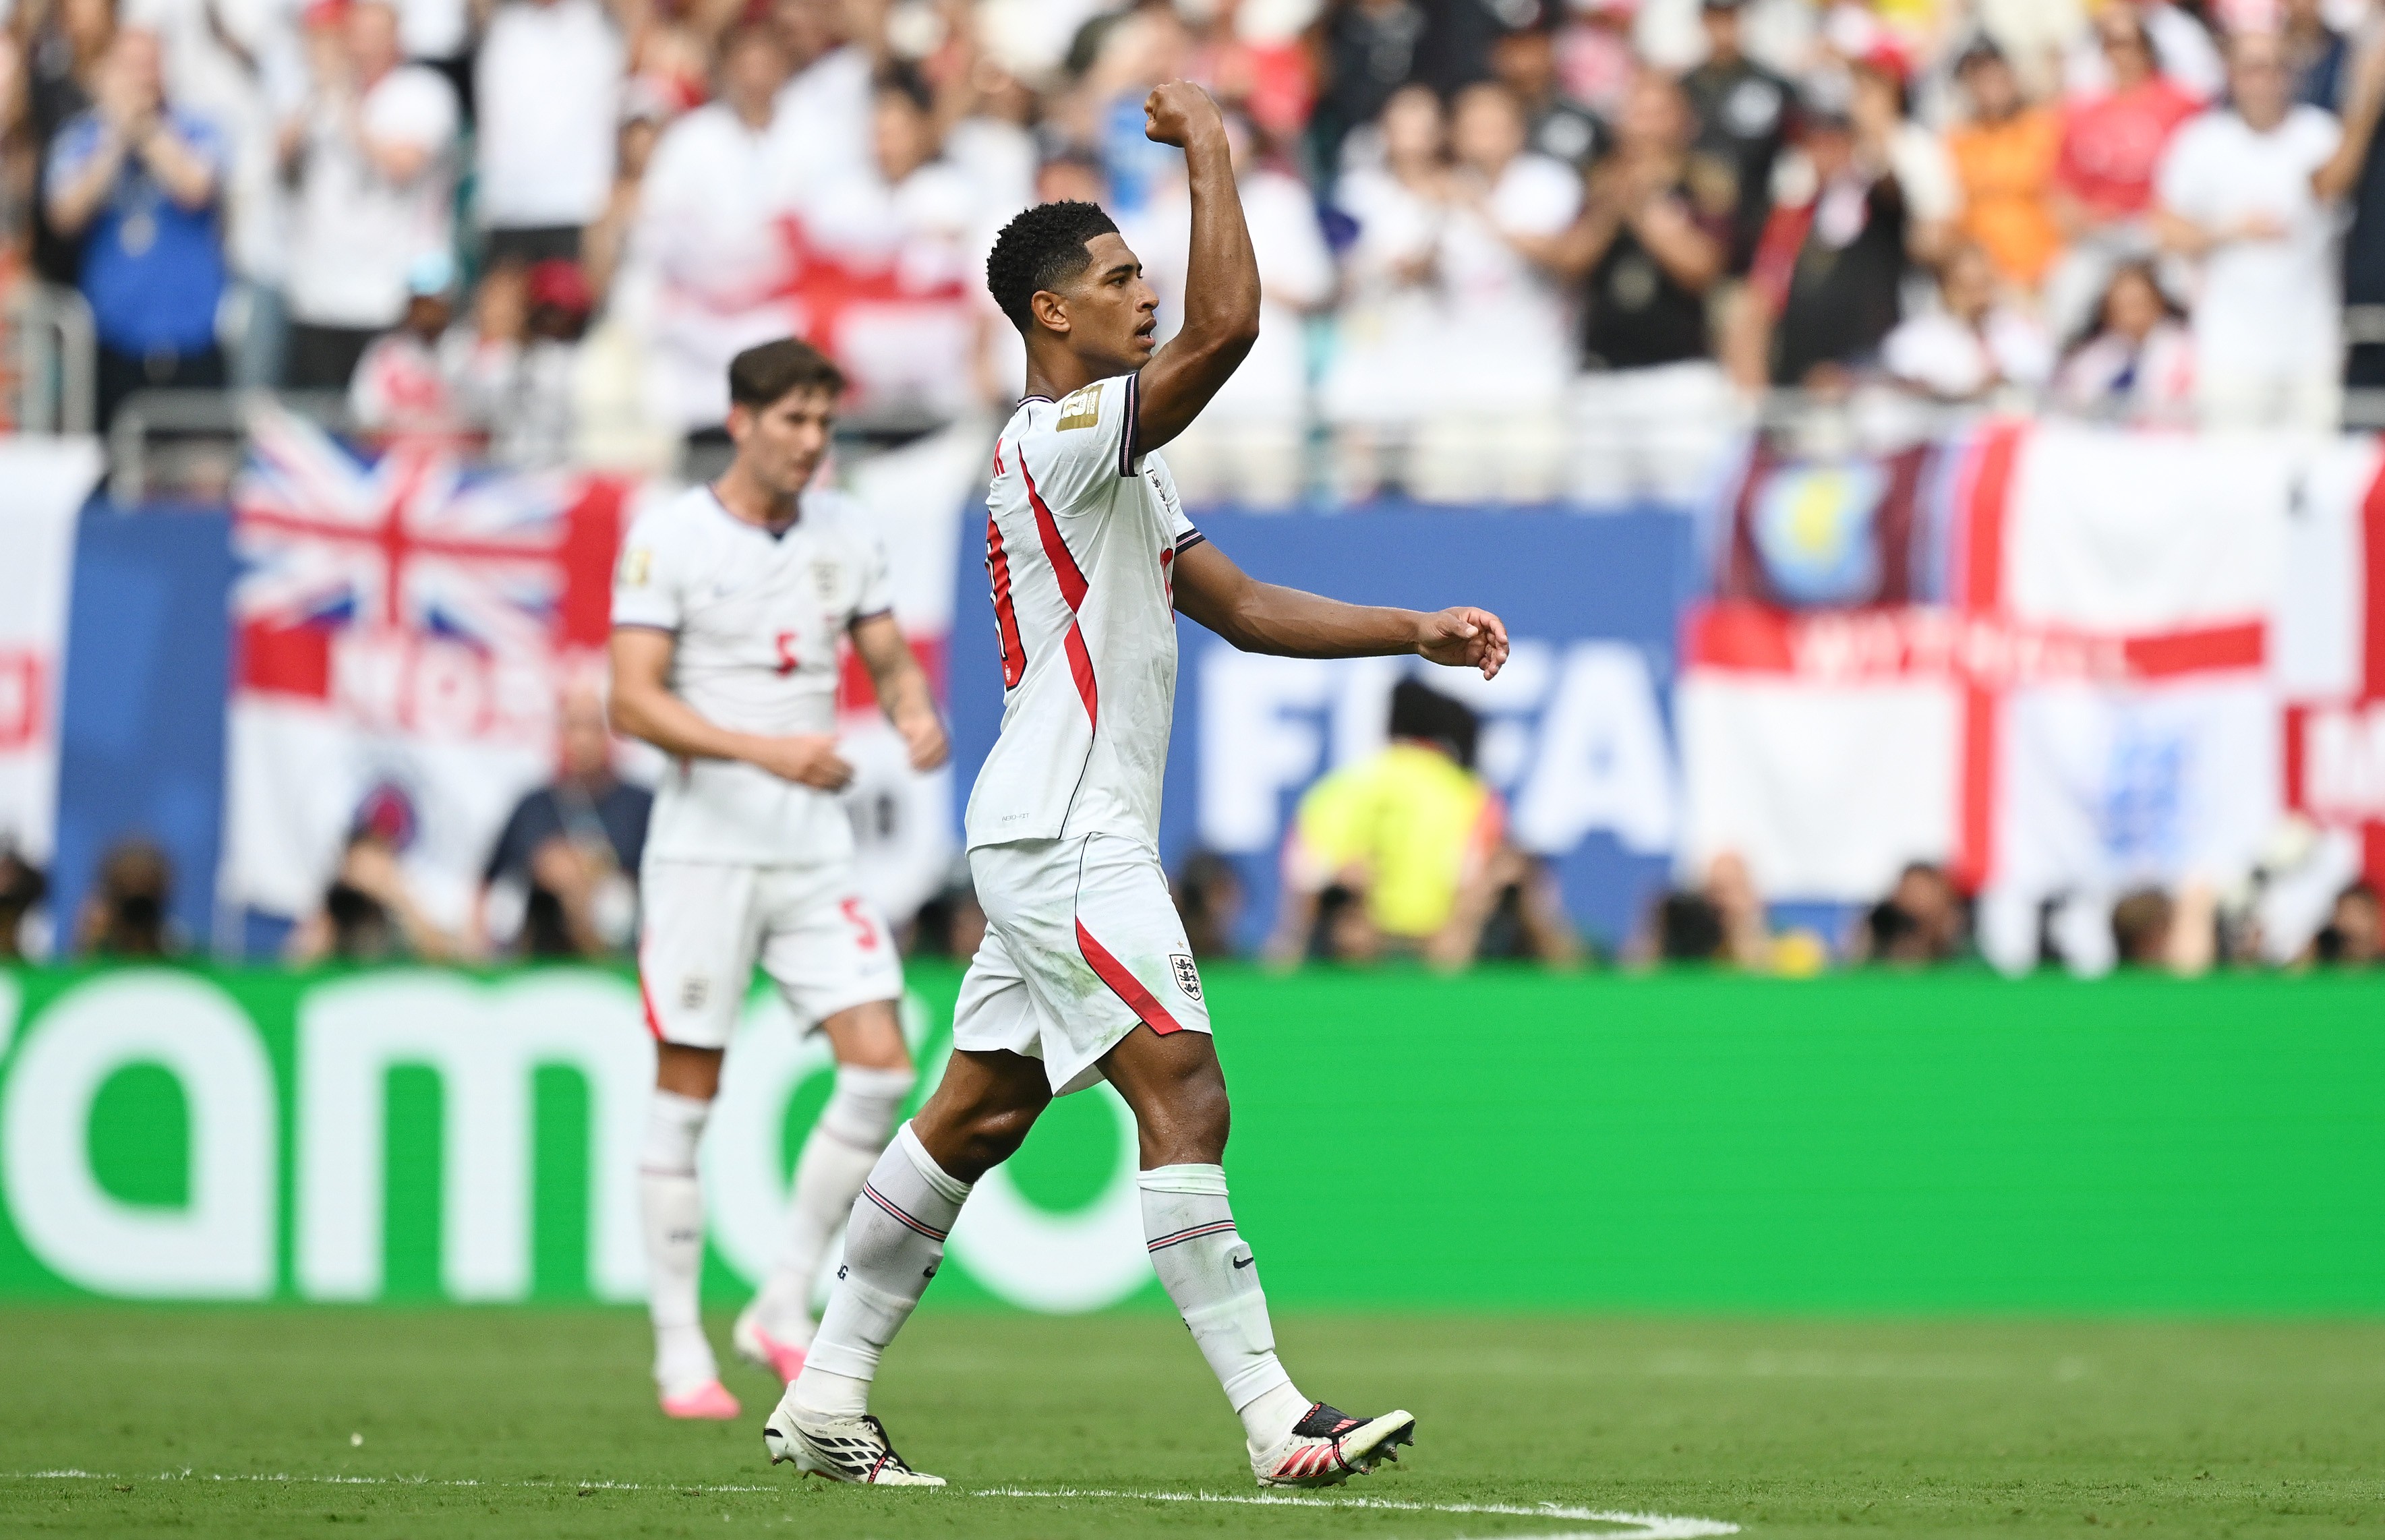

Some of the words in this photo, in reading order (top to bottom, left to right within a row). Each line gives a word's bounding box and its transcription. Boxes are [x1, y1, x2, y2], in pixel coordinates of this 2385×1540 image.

[775, 630, 799, 680] 5
[1001, 812, 1030, 822] AERO-FIT
[838, 895, 879, 953] 5
[0, 968, 1140, 1313] amco
